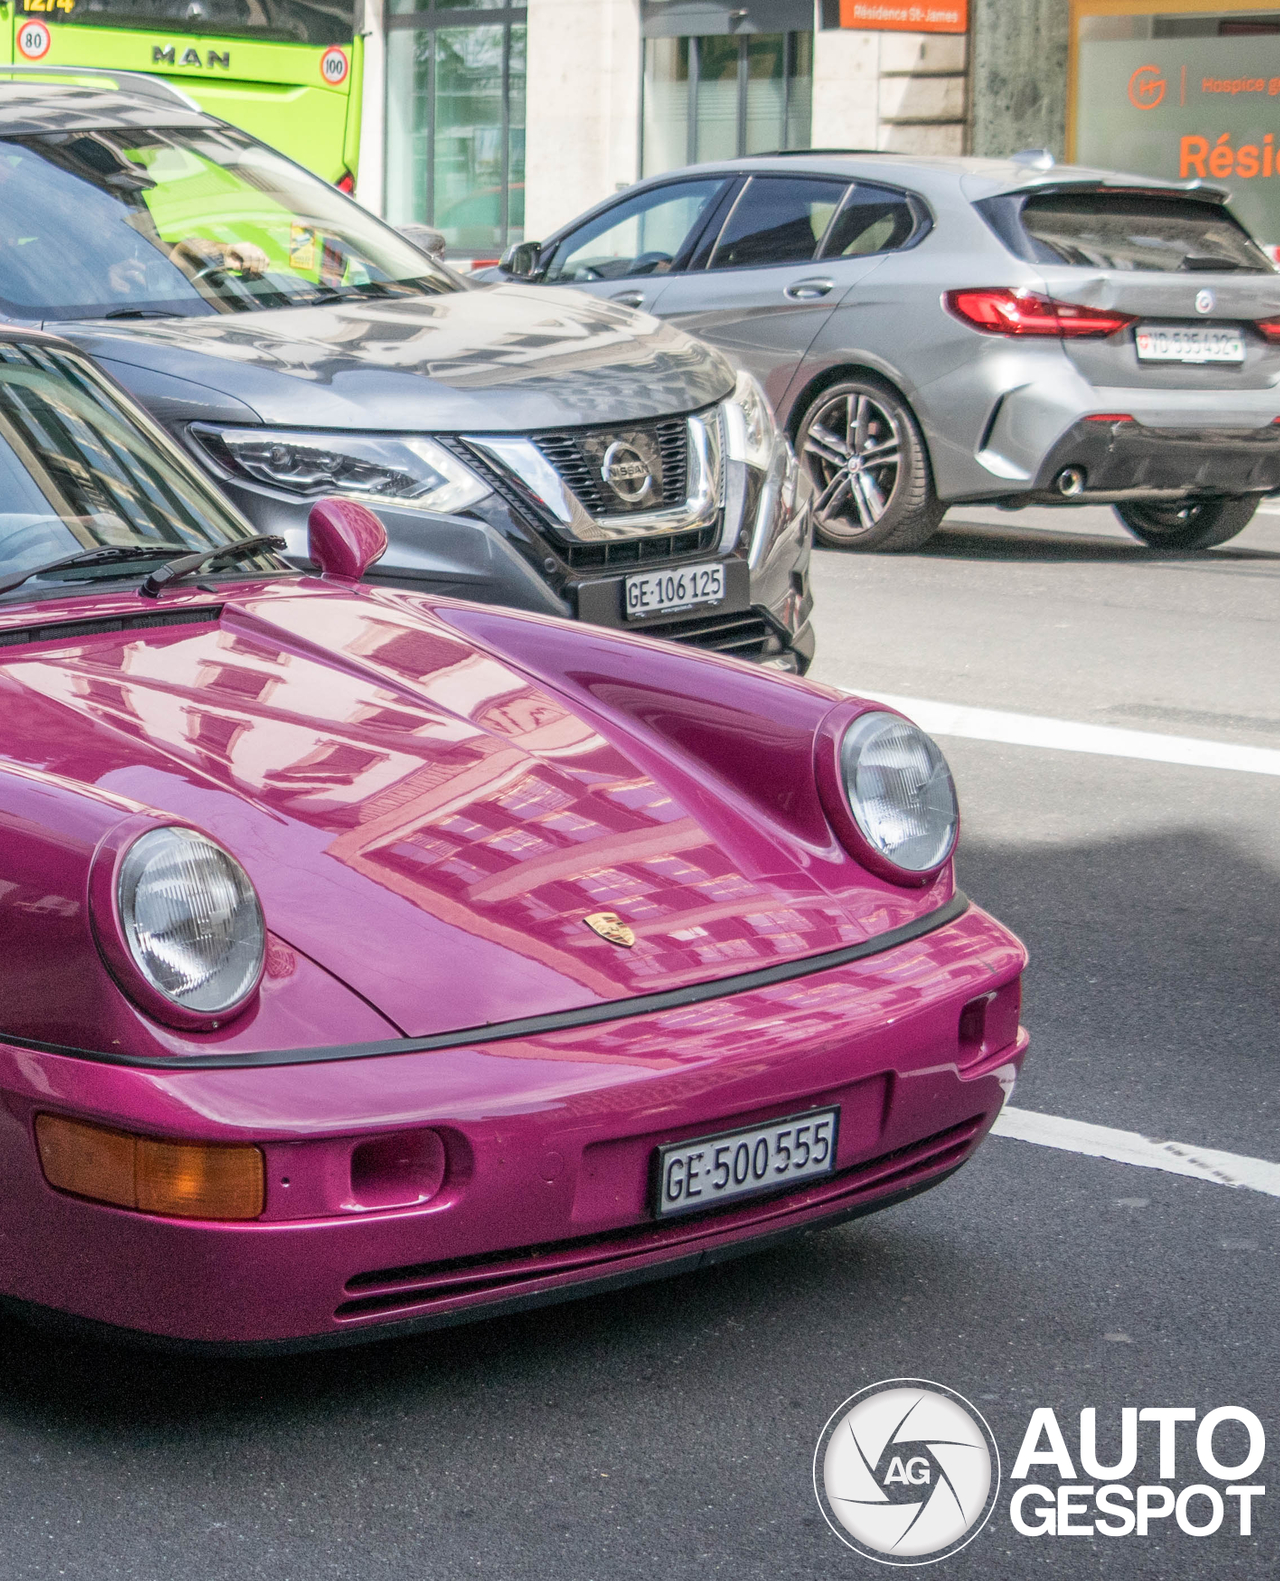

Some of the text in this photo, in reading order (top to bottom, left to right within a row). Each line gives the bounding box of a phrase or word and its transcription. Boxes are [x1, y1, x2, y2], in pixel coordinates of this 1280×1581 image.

[25, 33, 42, 48] 80
[152, 45, 231, 69] MAN
[326, 59, 343, 75] 100
[1202, 77, 1264, 95] Hospice
[608, 462, 649, 479] NISSAN
